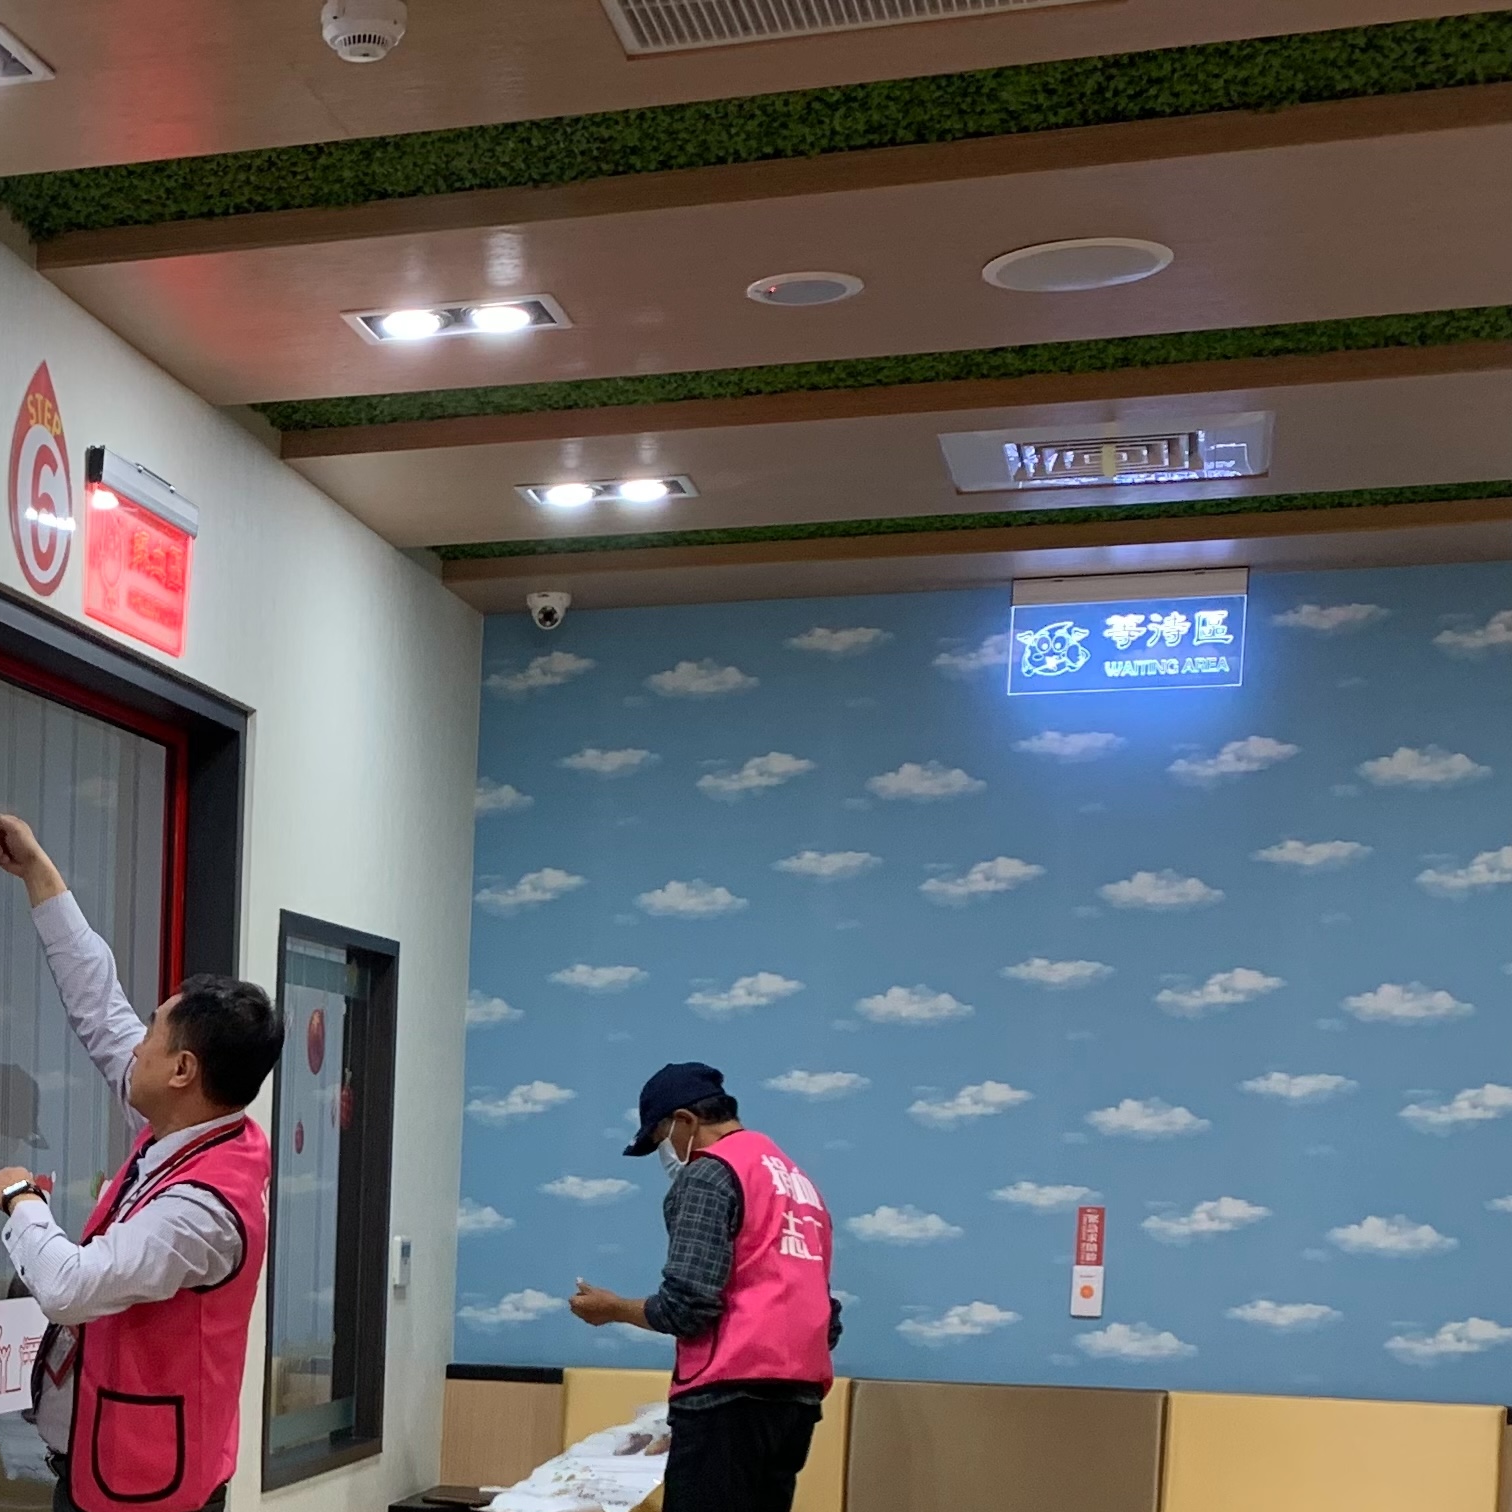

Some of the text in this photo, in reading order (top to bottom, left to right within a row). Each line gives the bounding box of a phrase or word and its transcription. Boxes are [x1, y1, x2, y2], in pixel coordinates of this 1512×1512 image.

[26, 393, 63, 437] STEP
[31, 444, 59, 572] 6
[1103, 610, 1234, 650] 等待區
[1104, 656, 1230, 677] WAITING AREA
